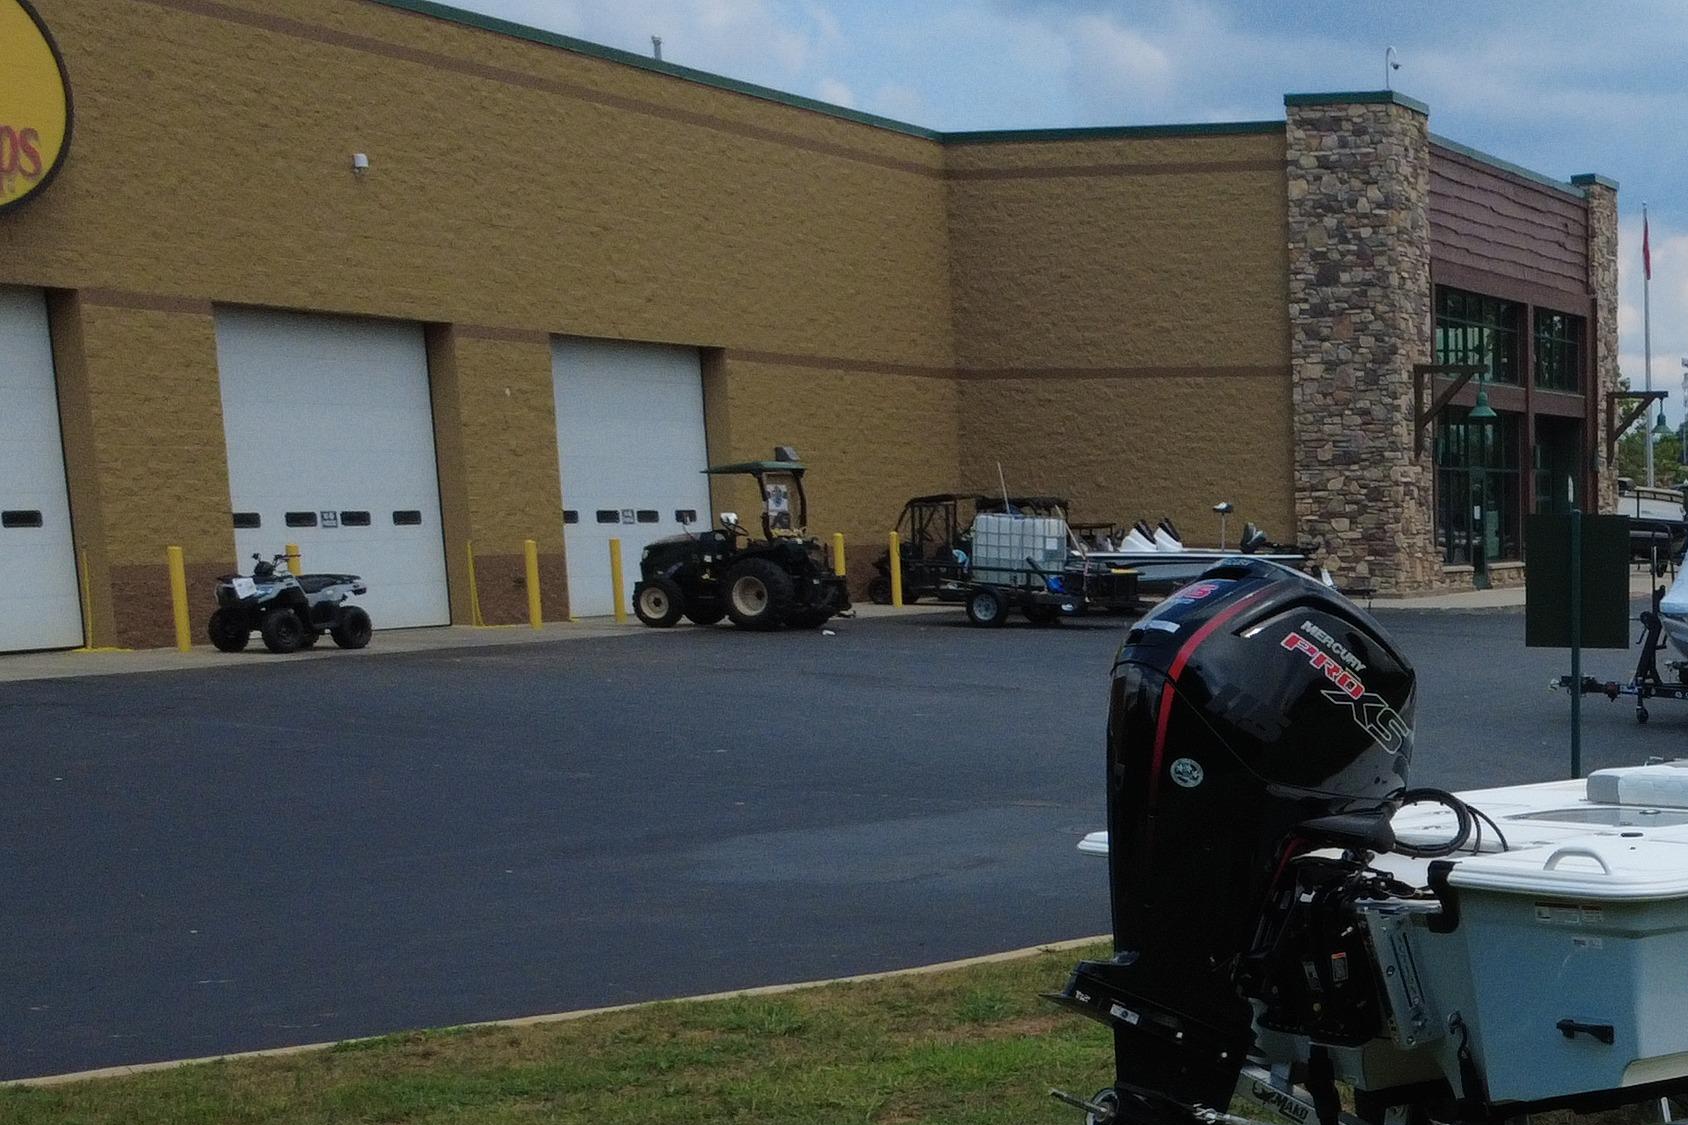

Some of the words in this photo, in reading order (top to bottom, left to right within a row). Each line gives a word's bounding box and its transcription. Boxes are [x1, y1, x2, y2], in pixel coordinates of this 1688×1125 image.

[1280, 631, 1366, 700] PRO
[1300, 620, 1367, 672] MERCURY
[1320, 689, 1411, 755] XS
[1270, 1093, 1309, 1125] MAKO
